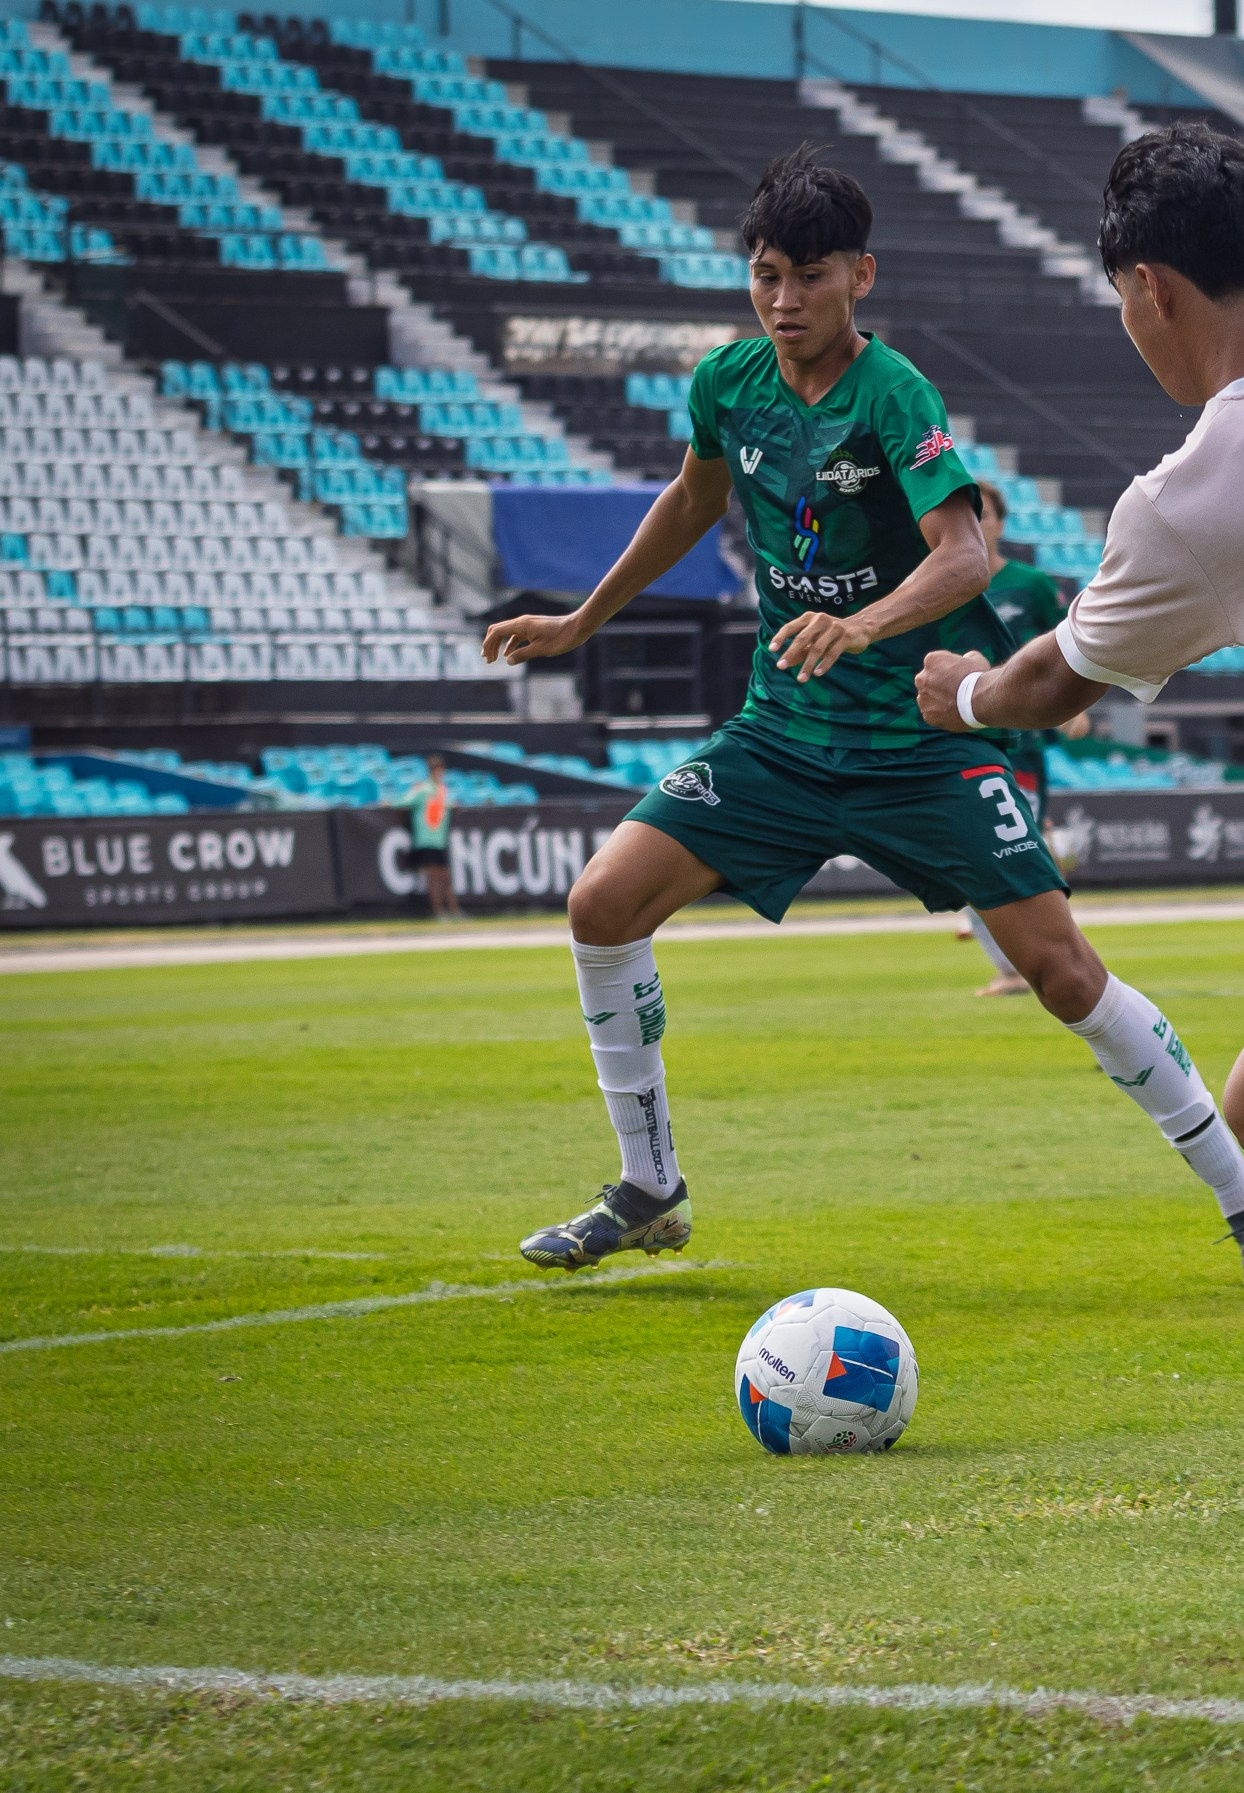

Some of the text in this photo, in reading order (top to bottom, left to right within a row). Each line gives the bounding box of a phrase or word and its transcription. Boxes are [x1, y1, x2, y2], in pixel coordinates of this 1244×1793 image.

[788, 590, 855, 605] EVENOS
[978, 776, 1029, 842] 3
[41, 828, 296, 878] BLUE CROW
[378, 815, 587, 896] CNCÚN
[758, 1347, 797, 1384] molten
